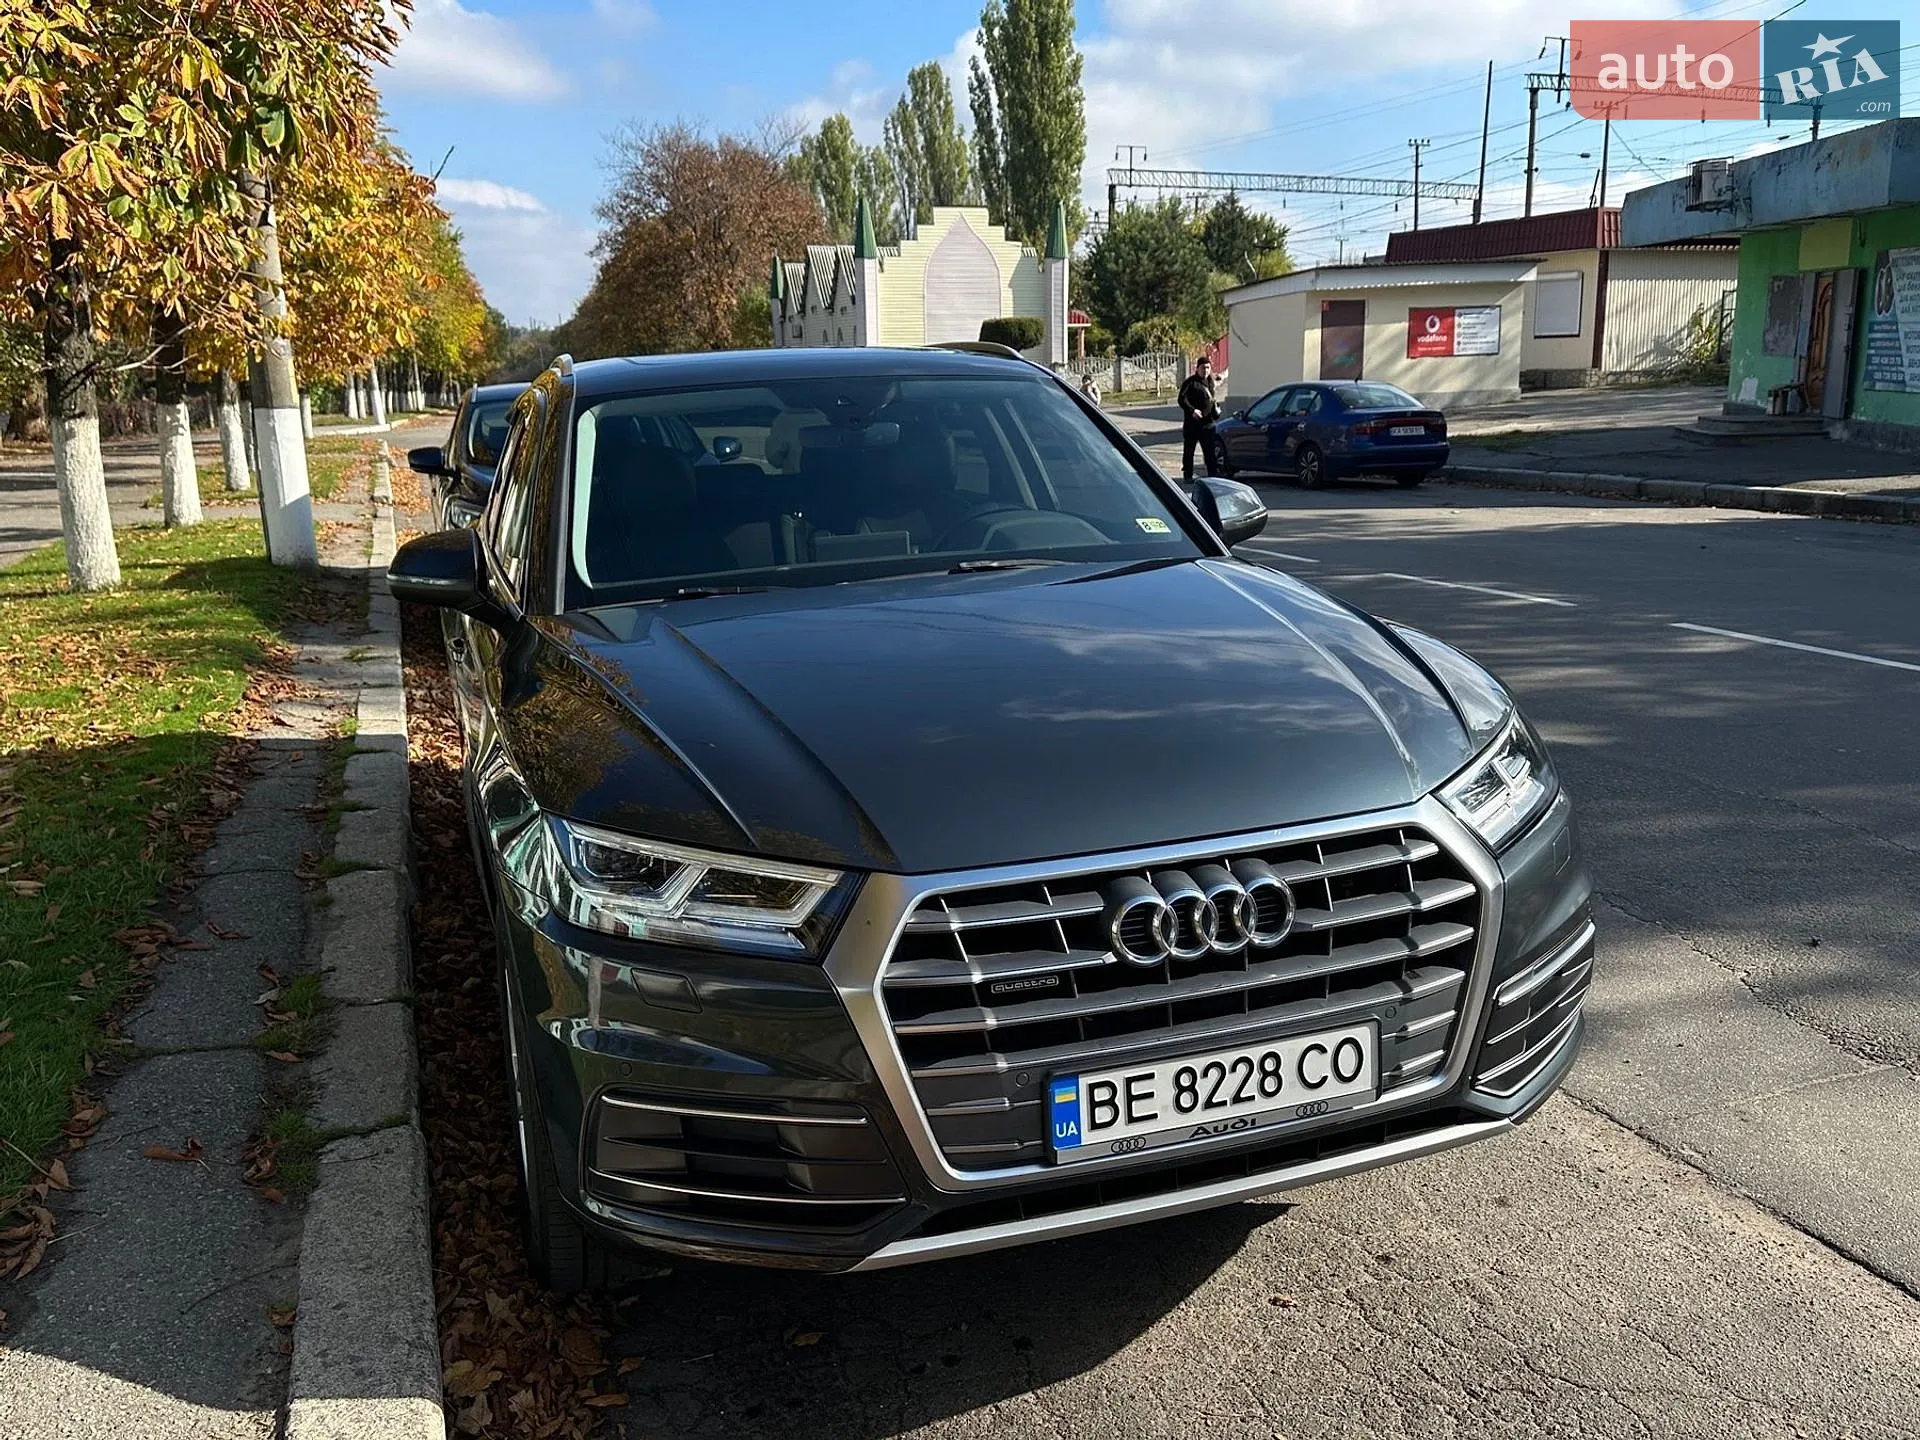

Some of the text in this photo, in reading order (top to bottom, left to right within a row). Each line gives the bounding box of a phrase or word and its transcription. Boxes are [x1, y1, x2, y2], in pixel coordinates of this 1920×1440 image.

[1417, 333, 1448, 343] vodafone
[994, 978, 1056, 993] quattro
[1088, 1036, 1364, 1132] BE 8228 CO
[1056, 1121, 1078, 1138] UA
[1189, 1118, 1257, 1139] Audi
